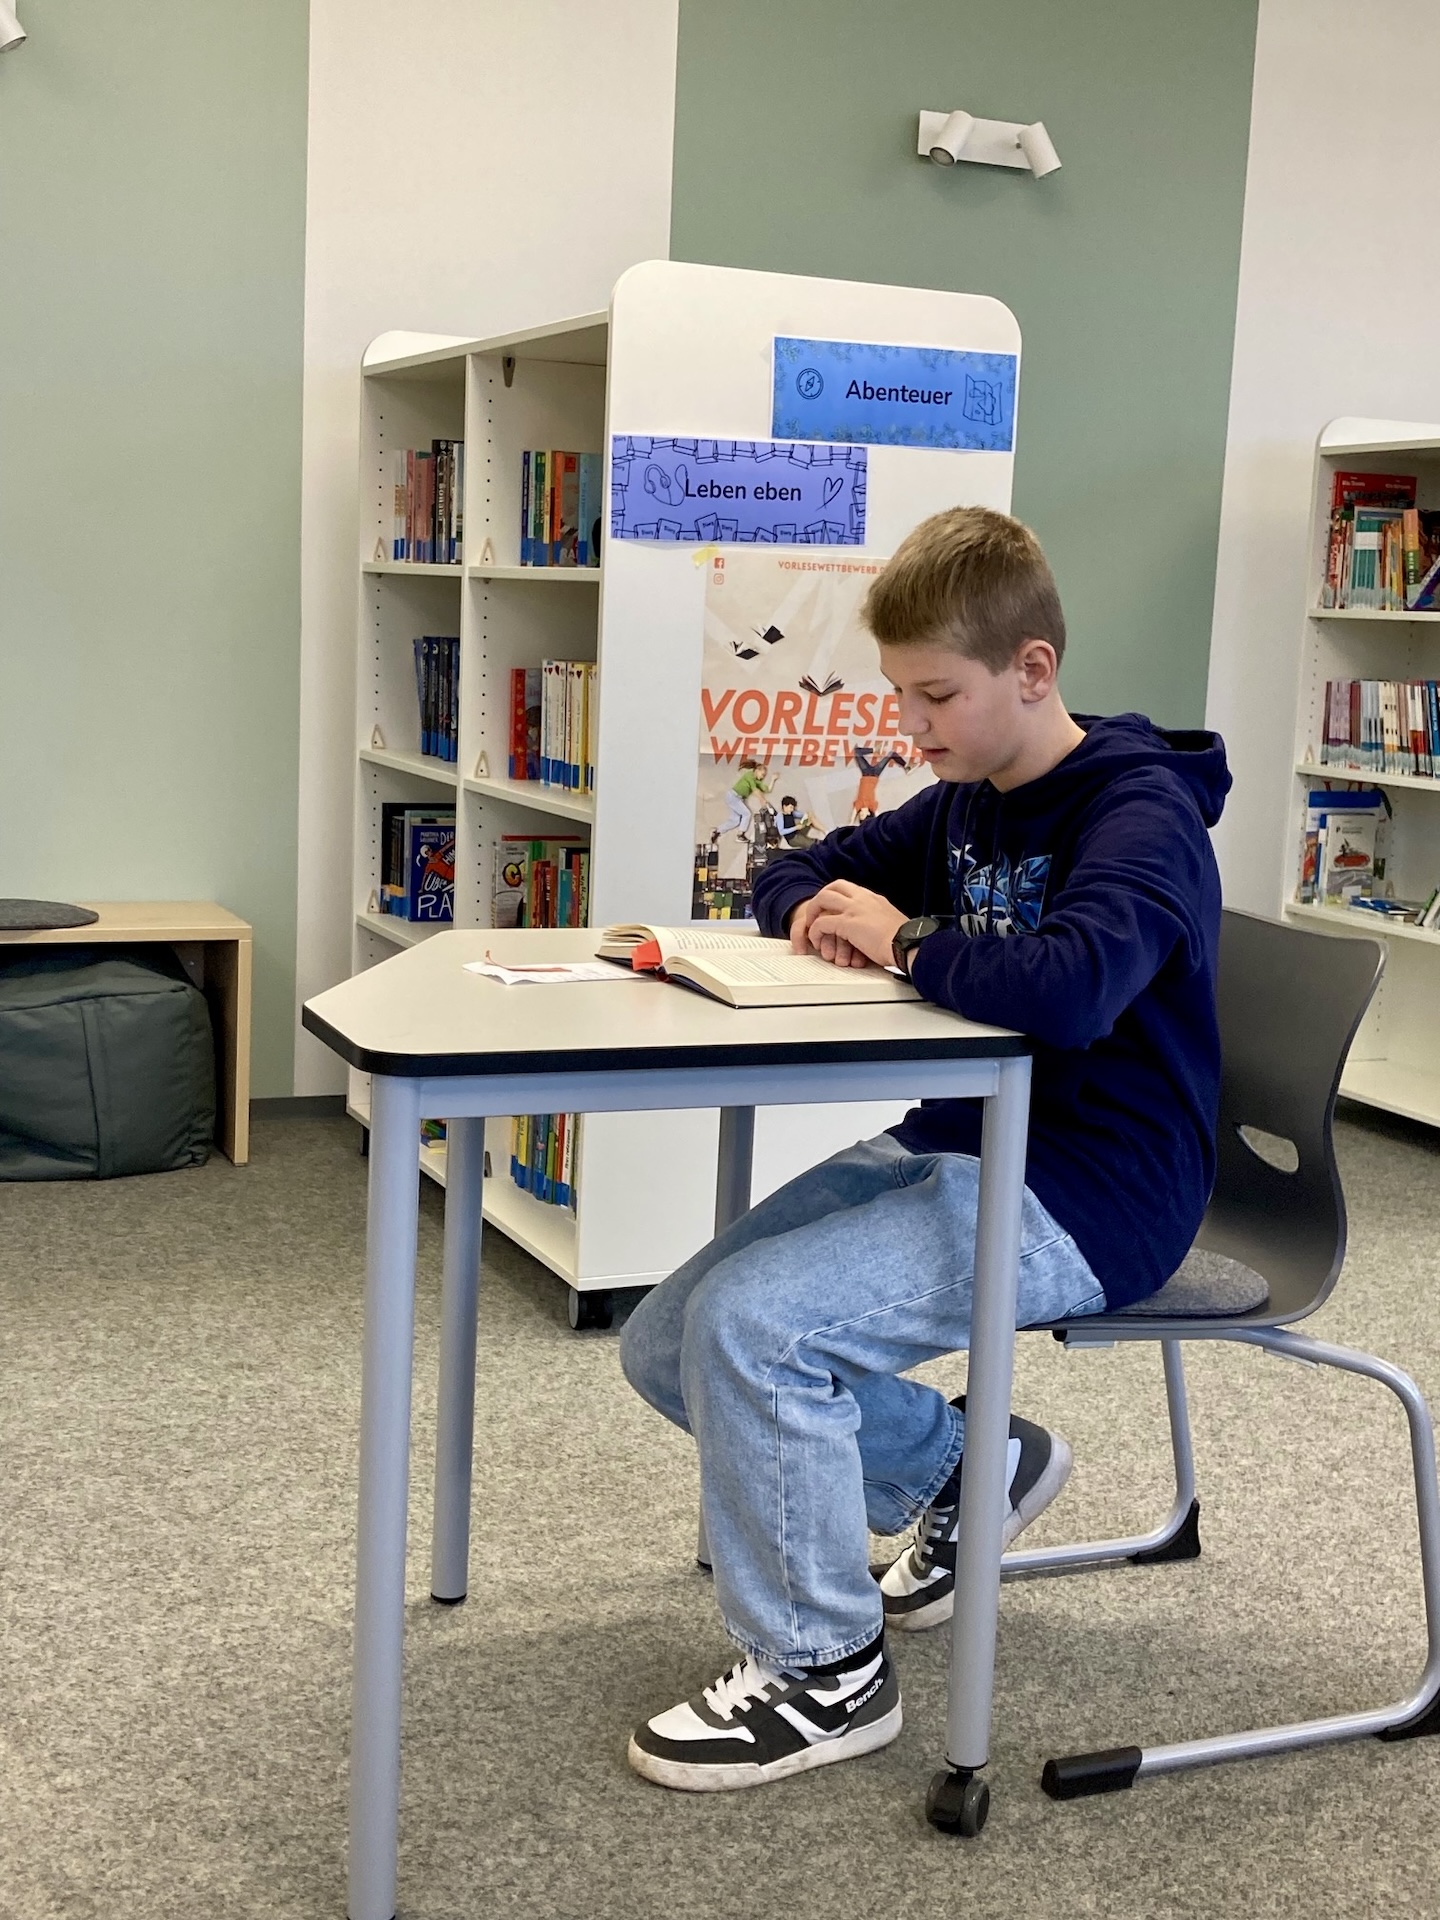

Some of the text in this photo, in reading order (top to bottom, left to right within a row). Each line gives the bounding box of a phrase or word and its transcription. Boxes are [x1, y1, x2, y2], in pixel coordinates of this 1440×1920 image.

[845, 379, 953, 406] Abenteuer
[685, 478, 802, 502] Leben eben
[701, 688, 900, 737] VORLESE
